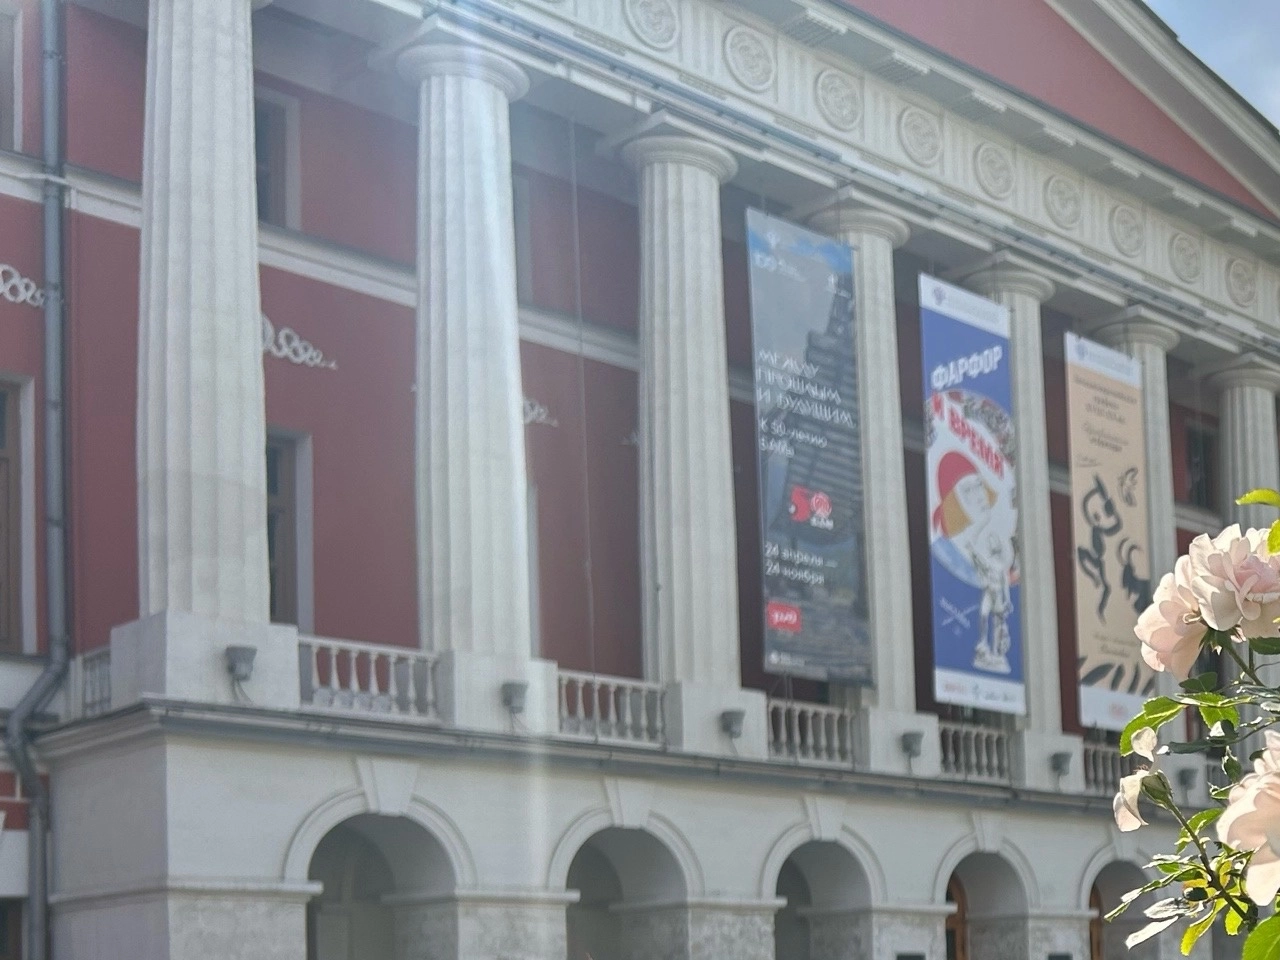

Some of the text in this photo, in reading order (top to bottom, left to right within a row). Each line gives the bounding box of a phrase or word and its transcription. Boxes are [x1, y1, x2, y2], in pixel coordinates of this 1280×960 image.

[931, 345, 1003, 390] ФАРФОР
[948, 405, 1004, 480] ВРЕМЯ
[765, 541, 779, 558] 24
[781, 548, 824, 568] апреля
[766, 558, 825, 586] 24 ноября
